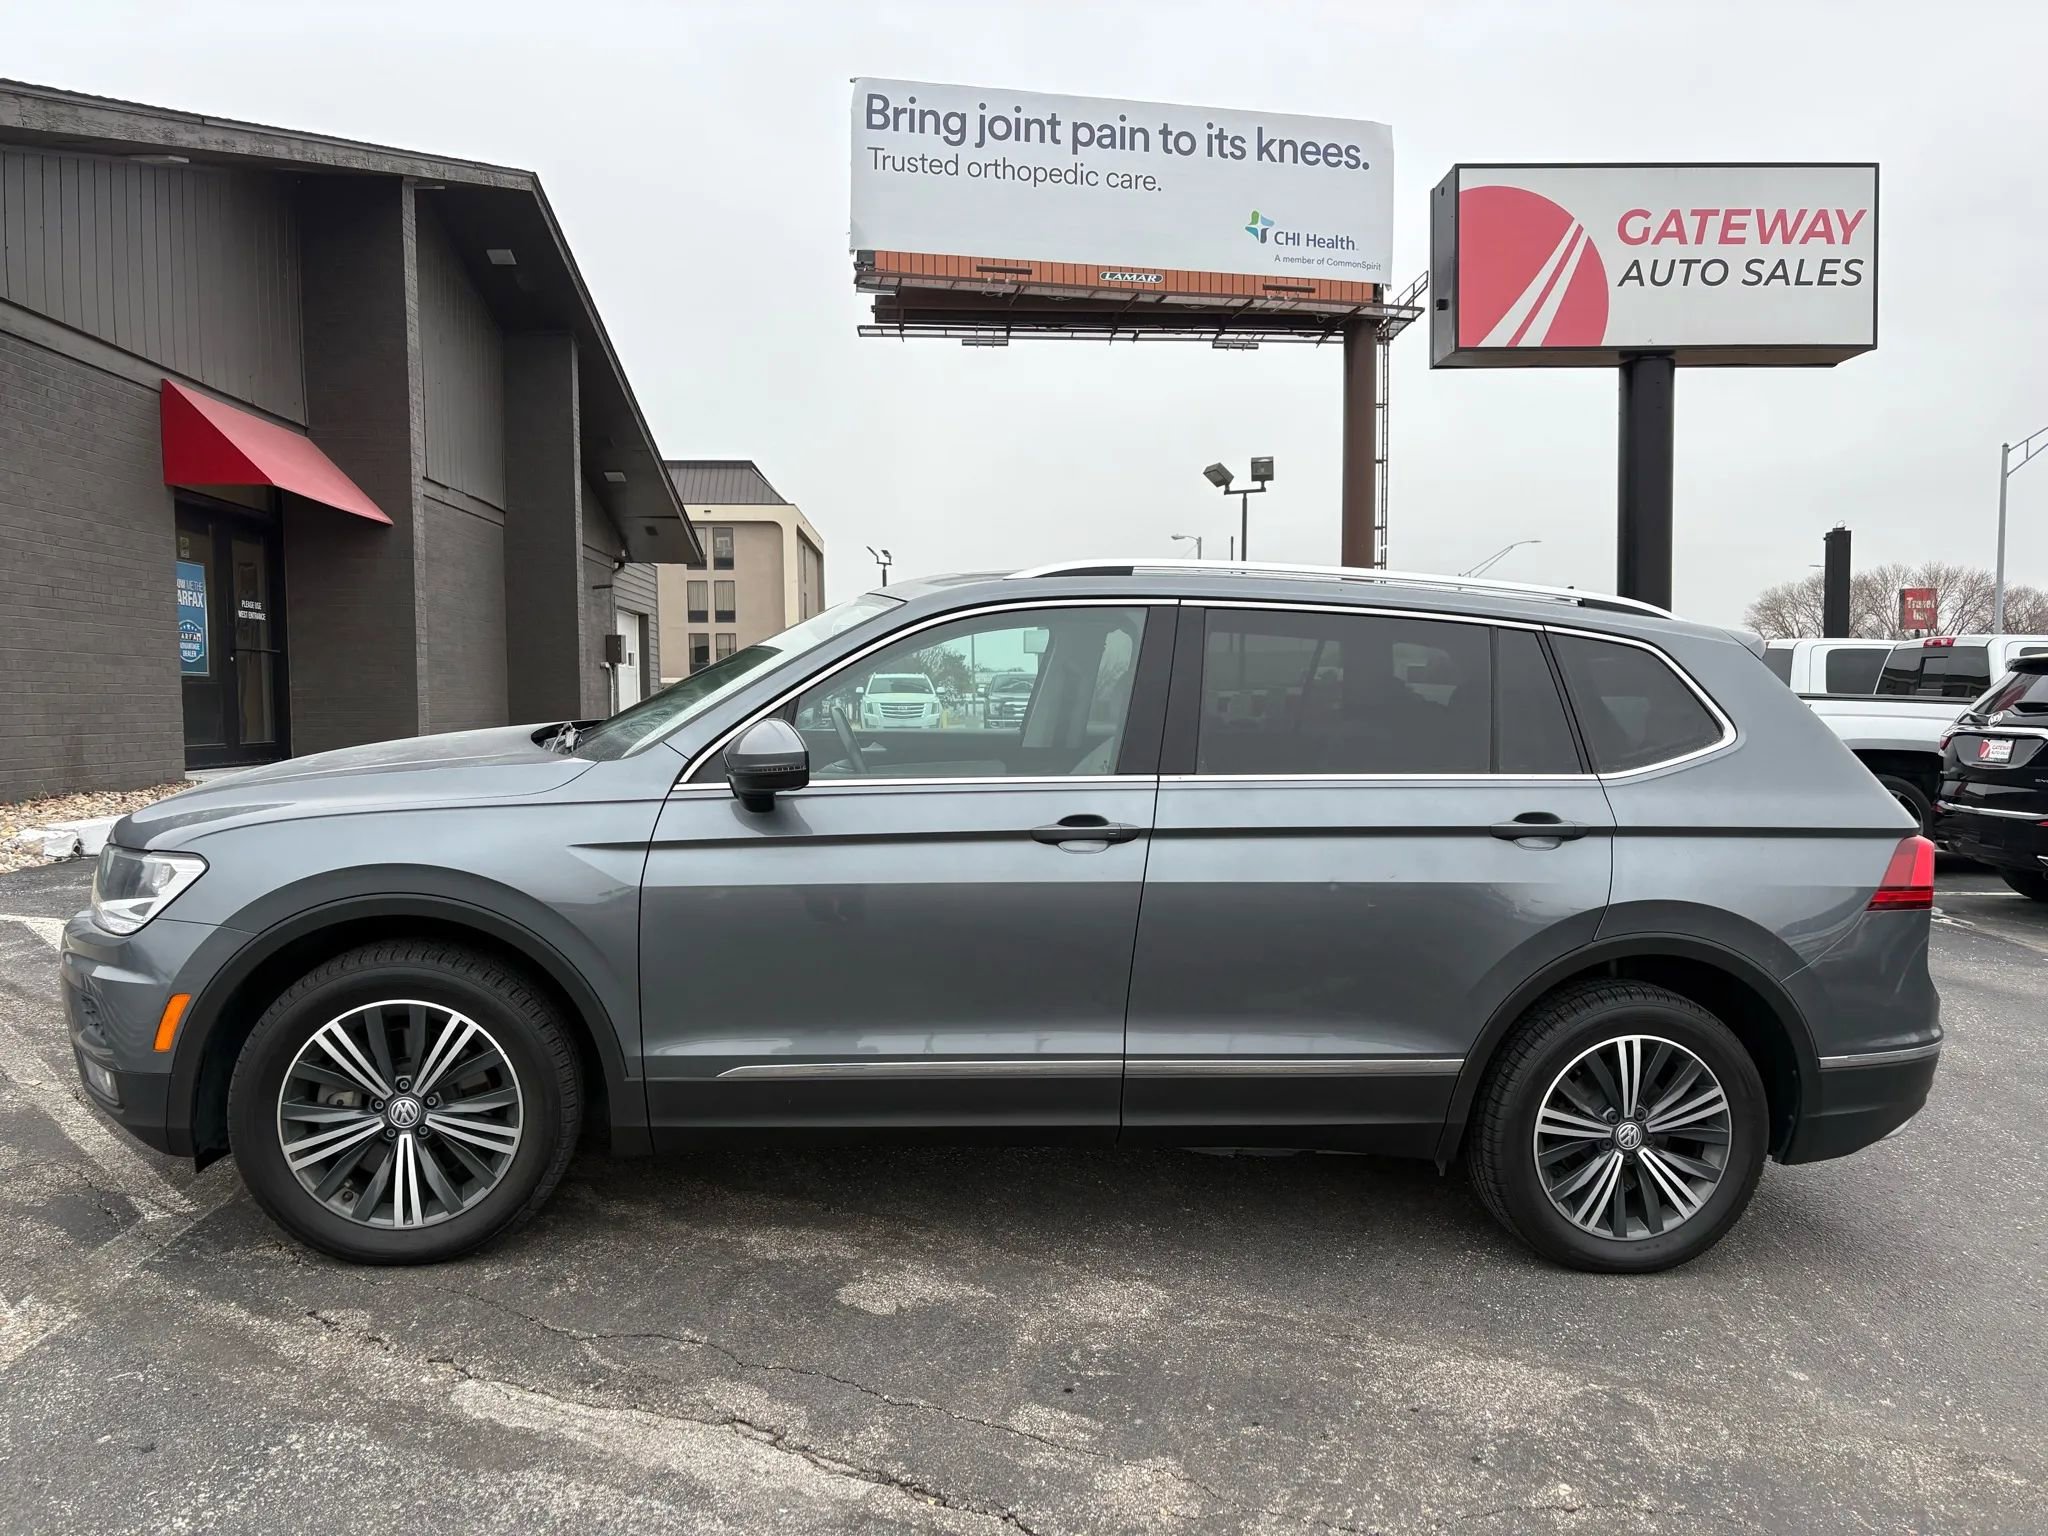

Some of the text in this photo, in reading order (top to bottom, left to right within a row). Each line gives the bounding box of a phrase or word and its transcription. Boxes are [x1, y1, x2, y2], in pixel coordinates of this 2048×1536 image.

[866, 93, 1370, 171] Bring joint pain to its knees.
[866, 146, 1162, 192] Trusted orthopedic care.
[1616, 208, 1868, 246] GATEWAY
[1274, 231, 1355, 251] CHI Health
[1274, 254, 1382, 271] A member of CommonSpirit
[1616, 258, 1865, 287] AUTO SALES
[1104, 272, 1158, 283] LAMAR
[177, 589, 204, 608] ARFAX
[241, 600, 254, 609] PLEASE
